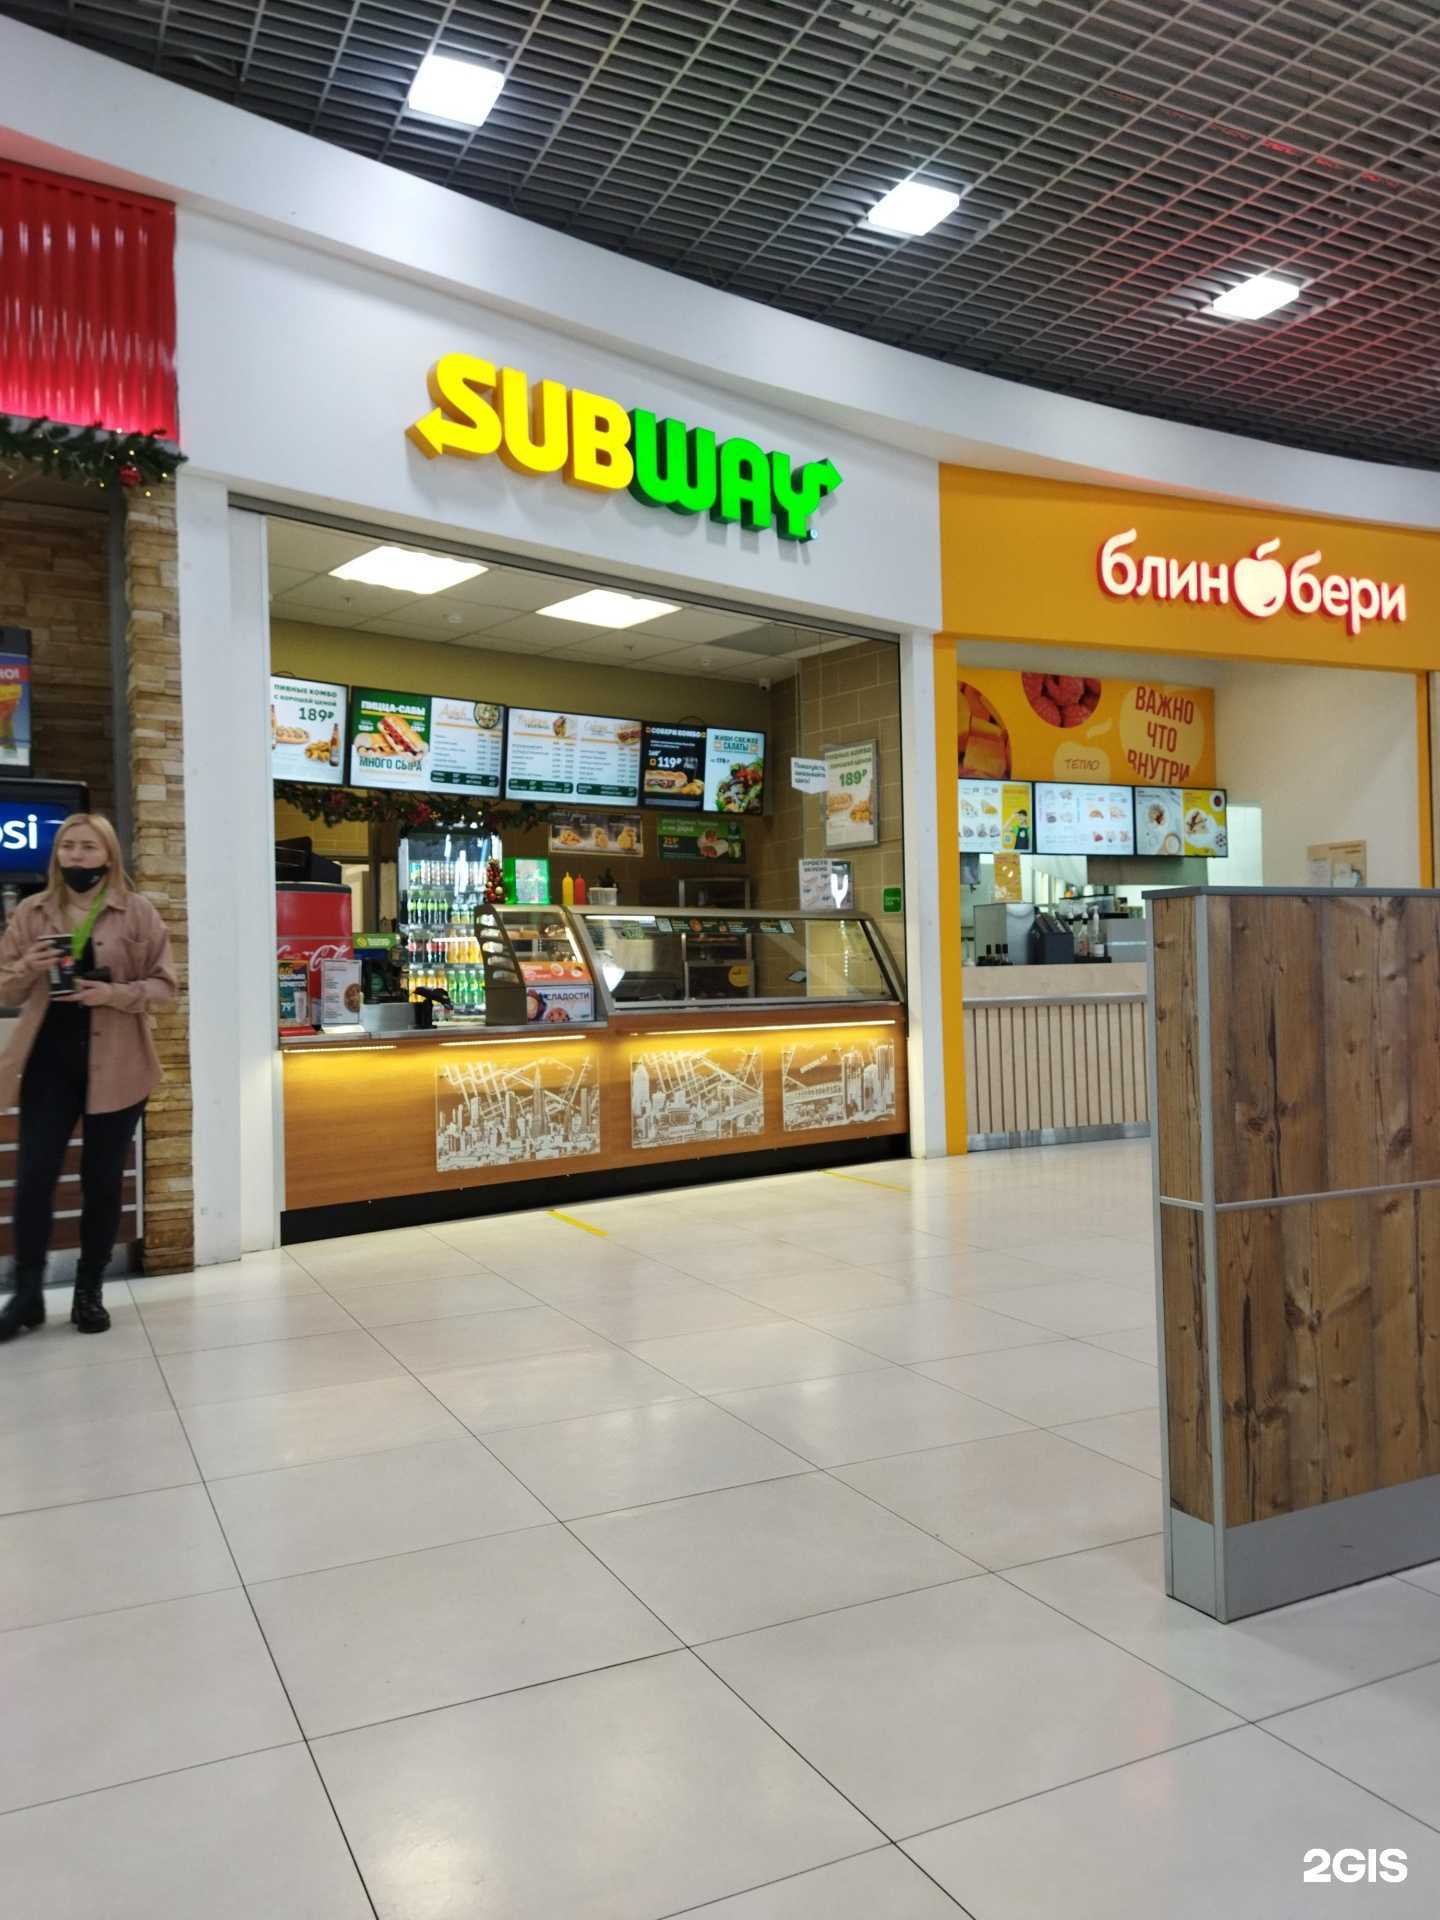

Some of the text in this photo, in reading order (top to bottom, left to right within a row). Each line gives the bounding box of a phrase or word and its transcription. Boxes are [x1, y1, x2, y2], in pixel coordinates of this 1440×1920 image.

[404, 352, 843, 542] SUBWAY
[1135, 685, 1194, 725] ВАЖНО
[723, 742, 749, 751] САЛАТЫ
[1147, 721, 1178, 752] ЧТО
[360, 757, 422, 772] МНОГО СЫРА
[1064, 758, 1100, 771] ТЕПЛО
[0, 814, 37, 850] si
[546, 992, 589, 1001] СЛАДОСТИ
